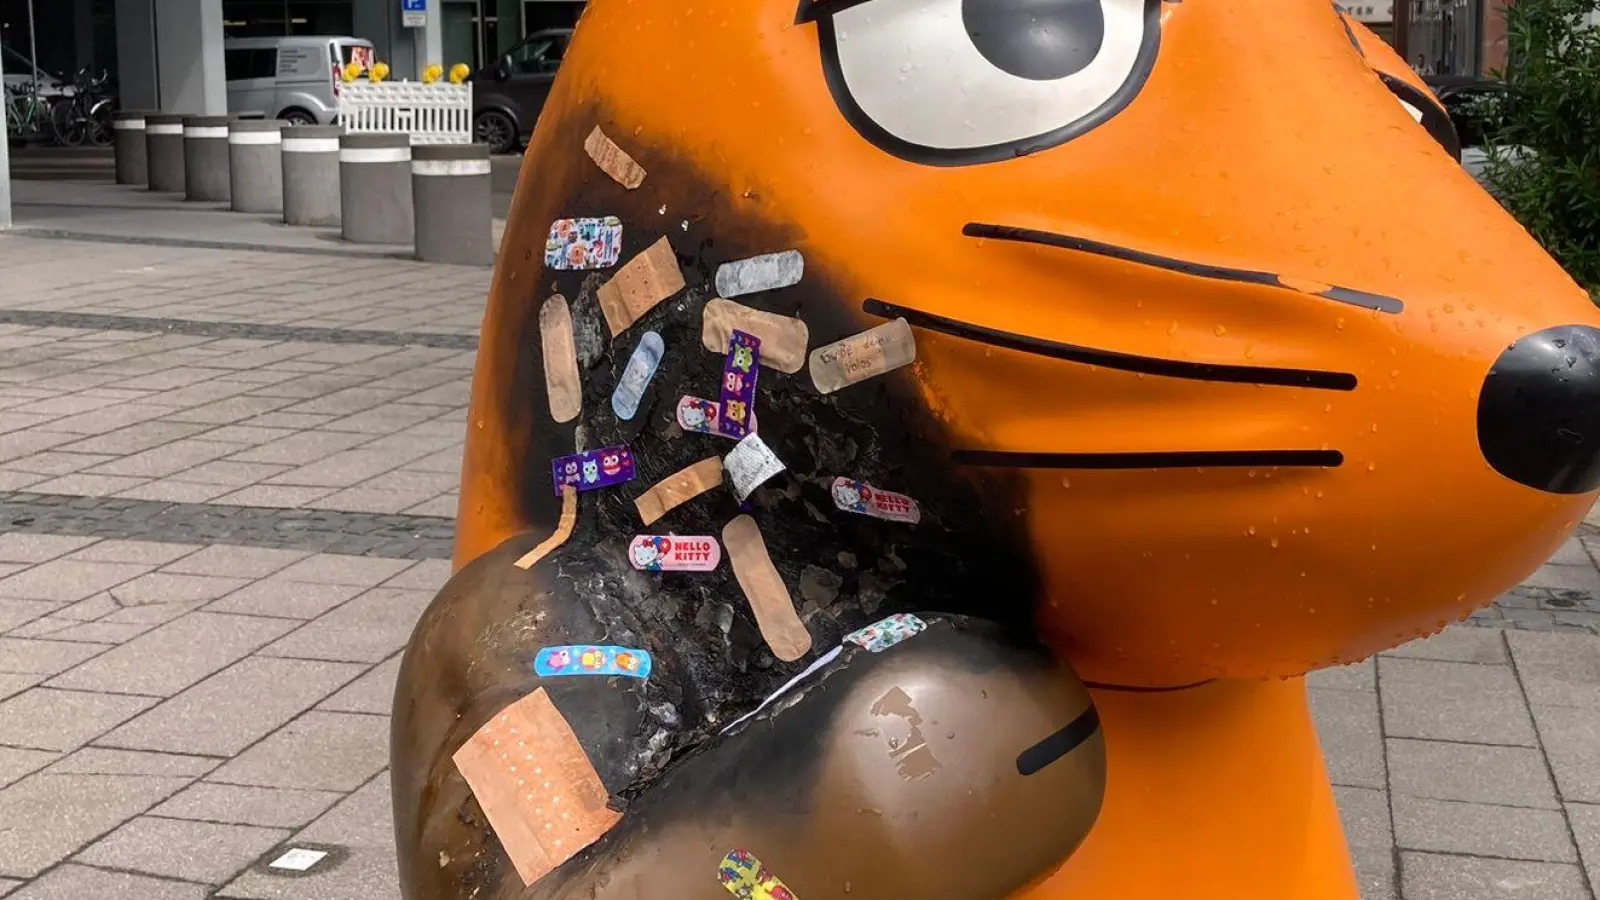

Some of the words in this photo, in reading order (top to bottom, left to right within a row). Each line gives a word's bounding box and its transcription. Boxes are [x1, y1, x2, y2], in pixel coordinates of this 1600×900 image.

[875, 493, 909, 505] HELLO
[876, 501, 910, 514] KITTY
[674, 542, 711, 551] HELLO
[675, 552, 711, 561] KITTY
